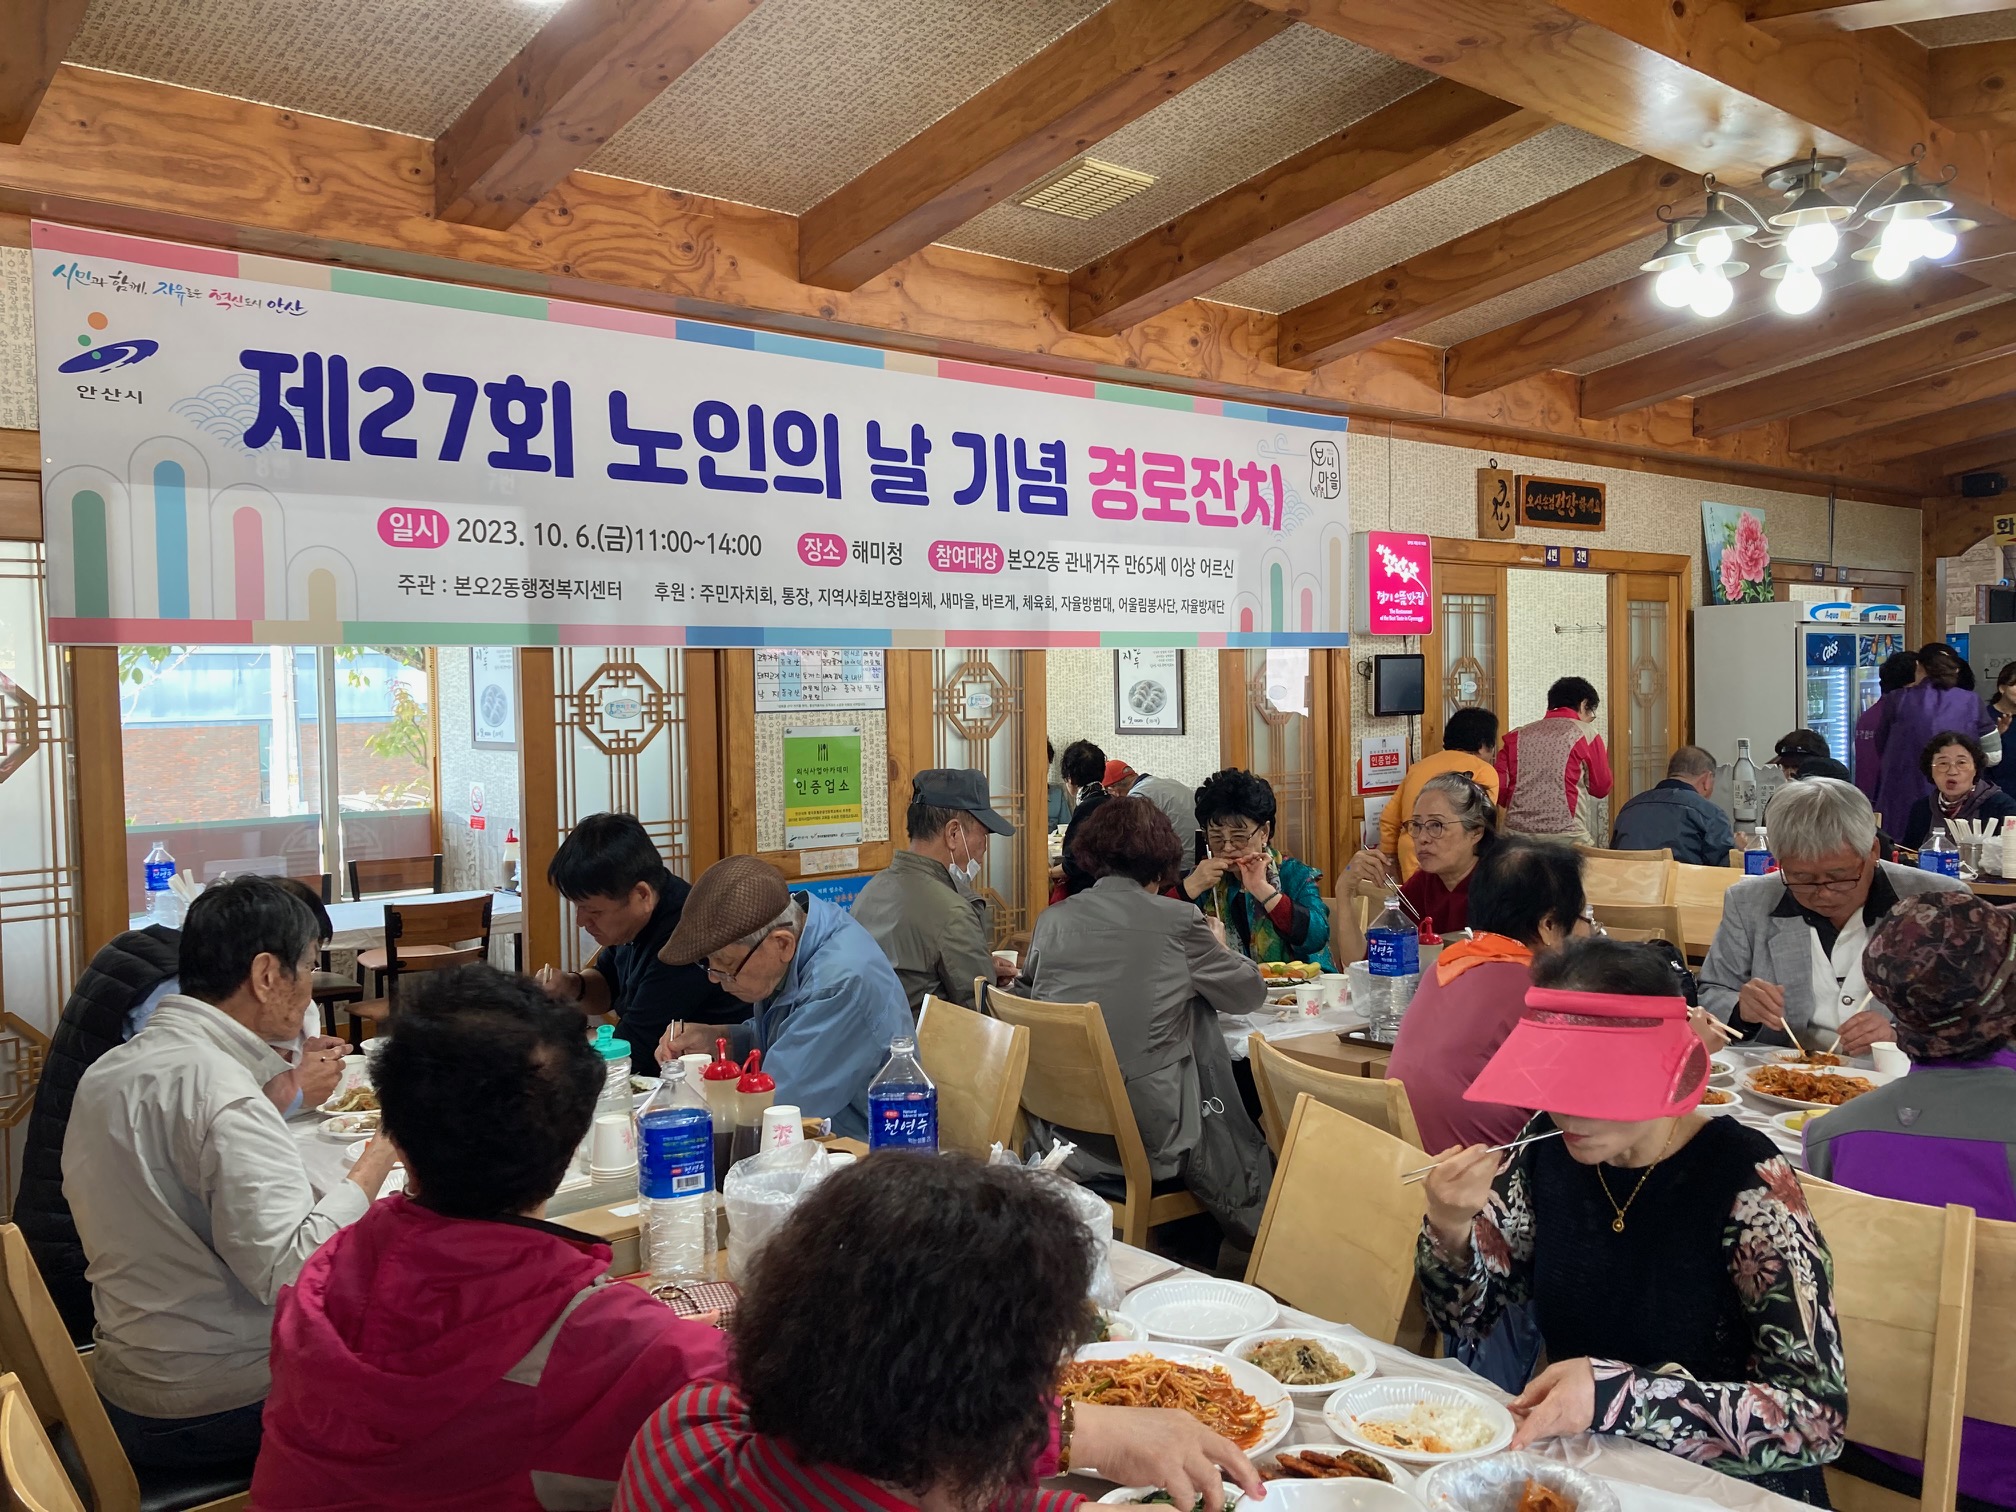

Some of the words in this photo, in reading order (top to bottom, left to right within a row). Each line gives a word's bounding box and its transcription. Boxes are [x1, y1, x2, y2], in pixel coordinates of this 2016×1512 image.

[52, 262, 107, 290] 시민과
[153, 281, 203, 306] 자유로운
[208, 289, 262, 310] 혁신도시
[267, 297, 308, 316] 안산
[77, 385, 142, 404] 안산시
[239, 349, 574, 478] 제27회
[607, 389, 843, 499] 노인의
[866, 420, 932, 506] 날
[952, 432, 1068, 517] 기념
[1088, 444, 1283, 530] 경로잔치
[1319, 471, 1338, 498] 마을
[390, 513, 439, 543] 일시
[457, 518, 524, 546] 2023.
[534, 523, 568, 548] 10.
[576, 523, 762, 557] 6.(금)11:00~14:00
[804, 538, 841, 562] 장소
[852, 540, 903, 566] 해미청
[1547, 549, 1558, 562] 4번
[1577, 551, 1587, 563] 3번
[936, 545, 998, 570] 참여대상
[1008, 549, 1060, 573] 본오2동
[1065, 551, 1120, 575] 관내거주
[1124, 554, 1167, 577] 만65세
[1171, 556, 1195, 578] 이상
[1200, 558, 1234, 579] 어르신
[398, 574, 435, 596] 주관
[454, 575, 622, 600] 본오2동행정복지센터
[654, 582, 685, 602] 후원
[700, 583, 777, 607] 주민자치회,
[781, 585, 813, 607] 통장,
[818, 588, 937, 609] 지역사회보장협의체,
[940, 592, 979, 610] 새마을,
[982, 594, 1019, 611] 바르게,
[1023, 594, 1057, 612] 체육회,
[1061, 595, 1115, 613] 자율방범대,
[1118, 597, 1178, 614] 어울림봉사단,
[1181, 598, 1225, 614] 자율방재단
[1376, 591, 1393, 604] 경기
[1825, 610, 1839, 619] Aqua
[1874, 613, 1887, 621] Aqua
[1823, 641, 1839, 662] Cass
[1371, 755, 1398, 767] 인증업소
[796, 766, 849, 775] 외식사업아카데미
[796, 779, 850, 796] 인증업소
[1370, 945, 1394, 956] 천연수
[884, 1118, 928, 1136] 천연수
